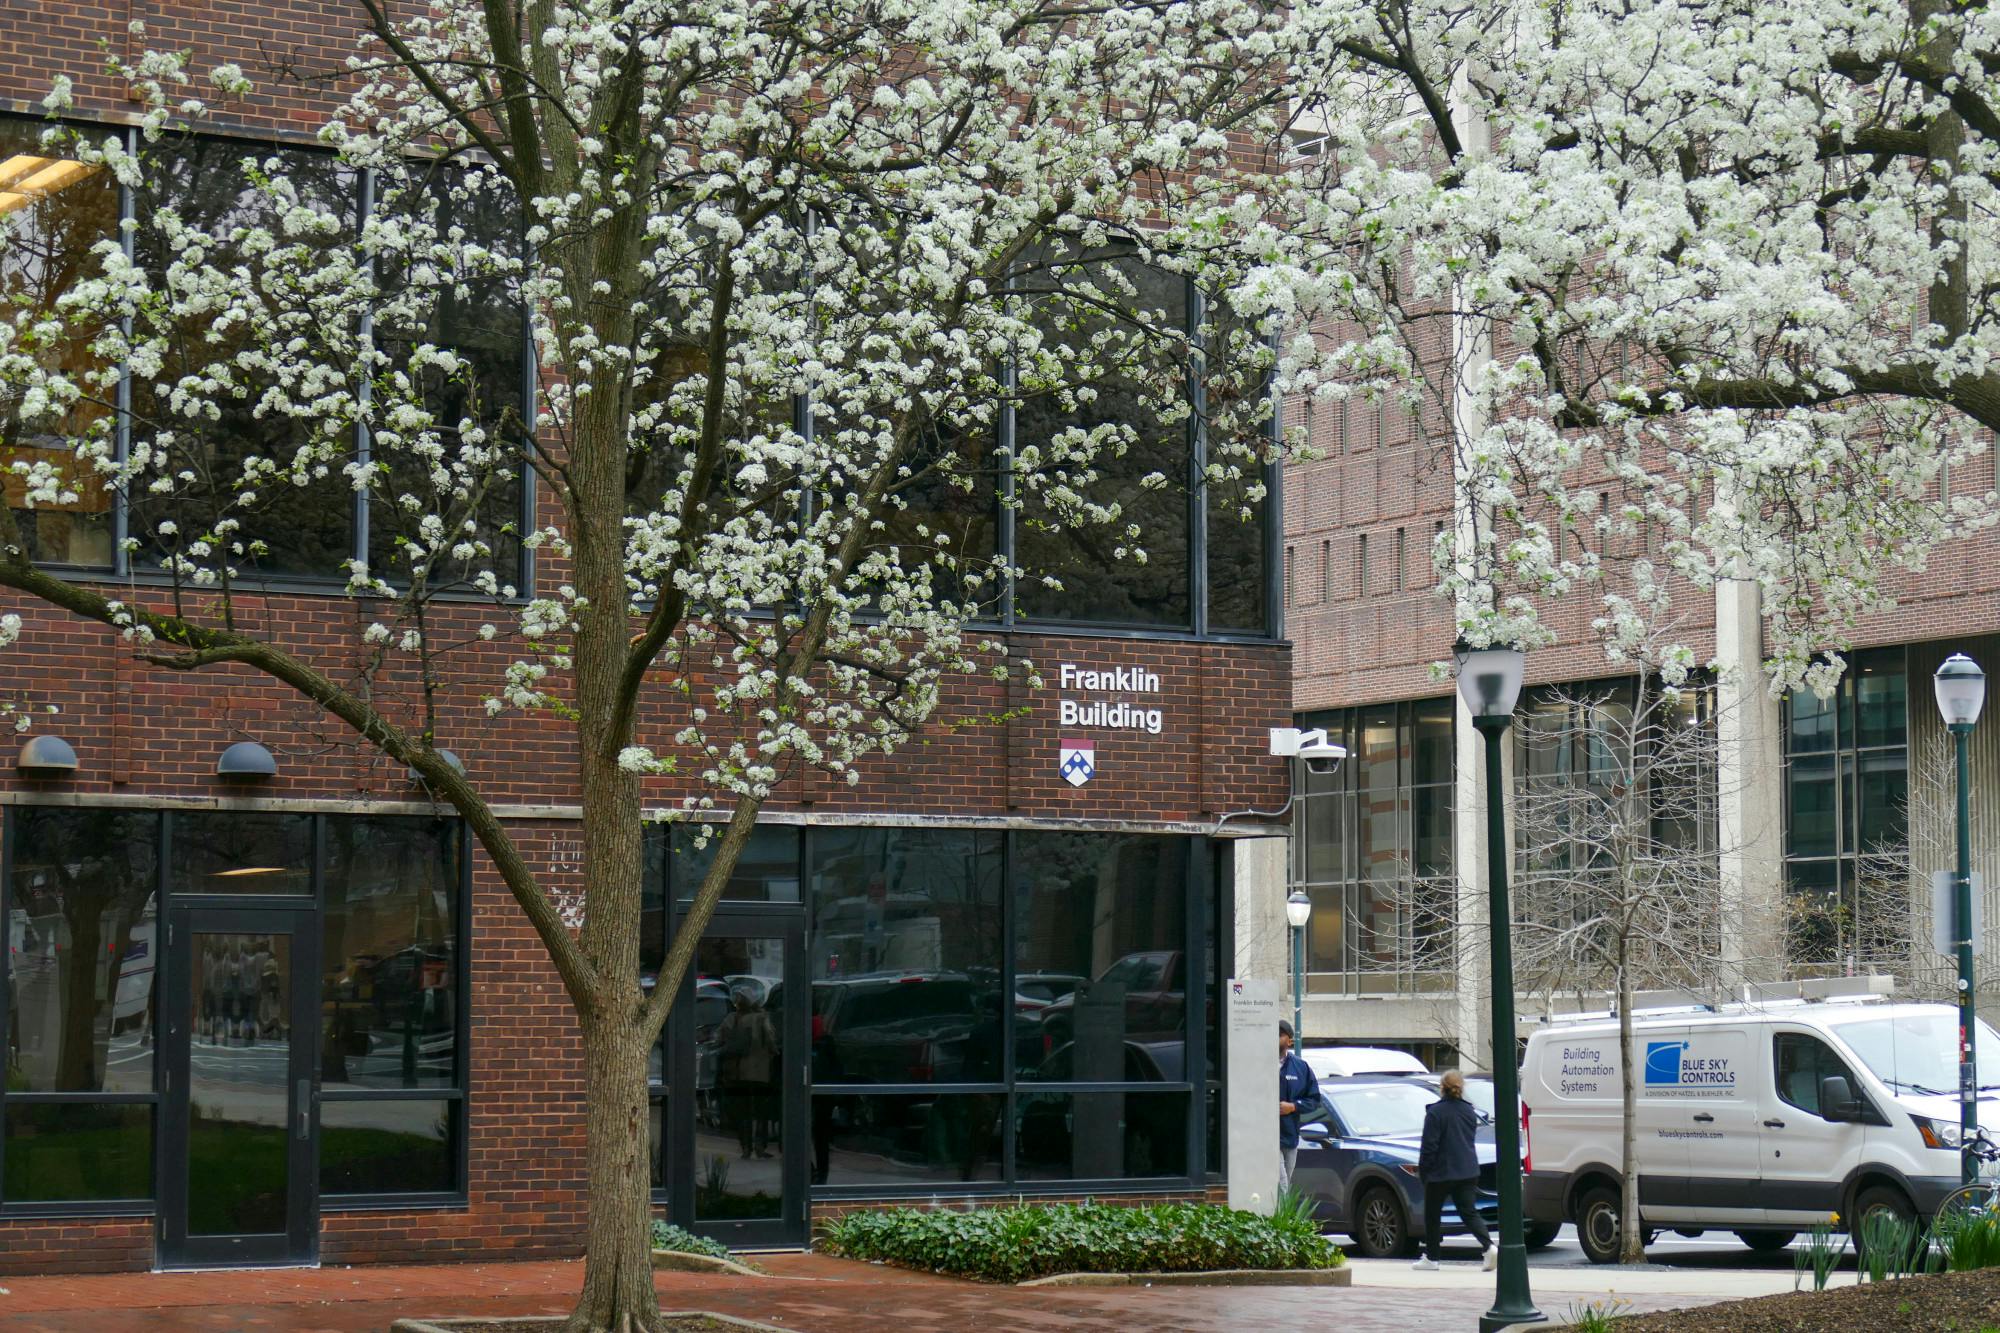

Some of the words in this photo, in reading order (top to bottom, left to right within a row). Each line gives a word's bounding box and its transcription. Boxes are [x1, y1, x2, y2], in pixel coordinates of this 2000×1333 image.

[1060, 664, 1159, 692] Franklin
[1060, 700, 1162, 734] Building
[1563, 1048, 1600, 1063] Building
[1561, 1064, 1614, 1076] Automation
[1682, 1060, 1705, 1071] BLUE
[1708, 1059, 1728, 1070] SKY
[1681, 1072, 1735, 1083] CONTROLS
[1561, 1079, 1597, 1095] Systems
[1658, 1128, 1723, 1140] blueskycontrols.com
